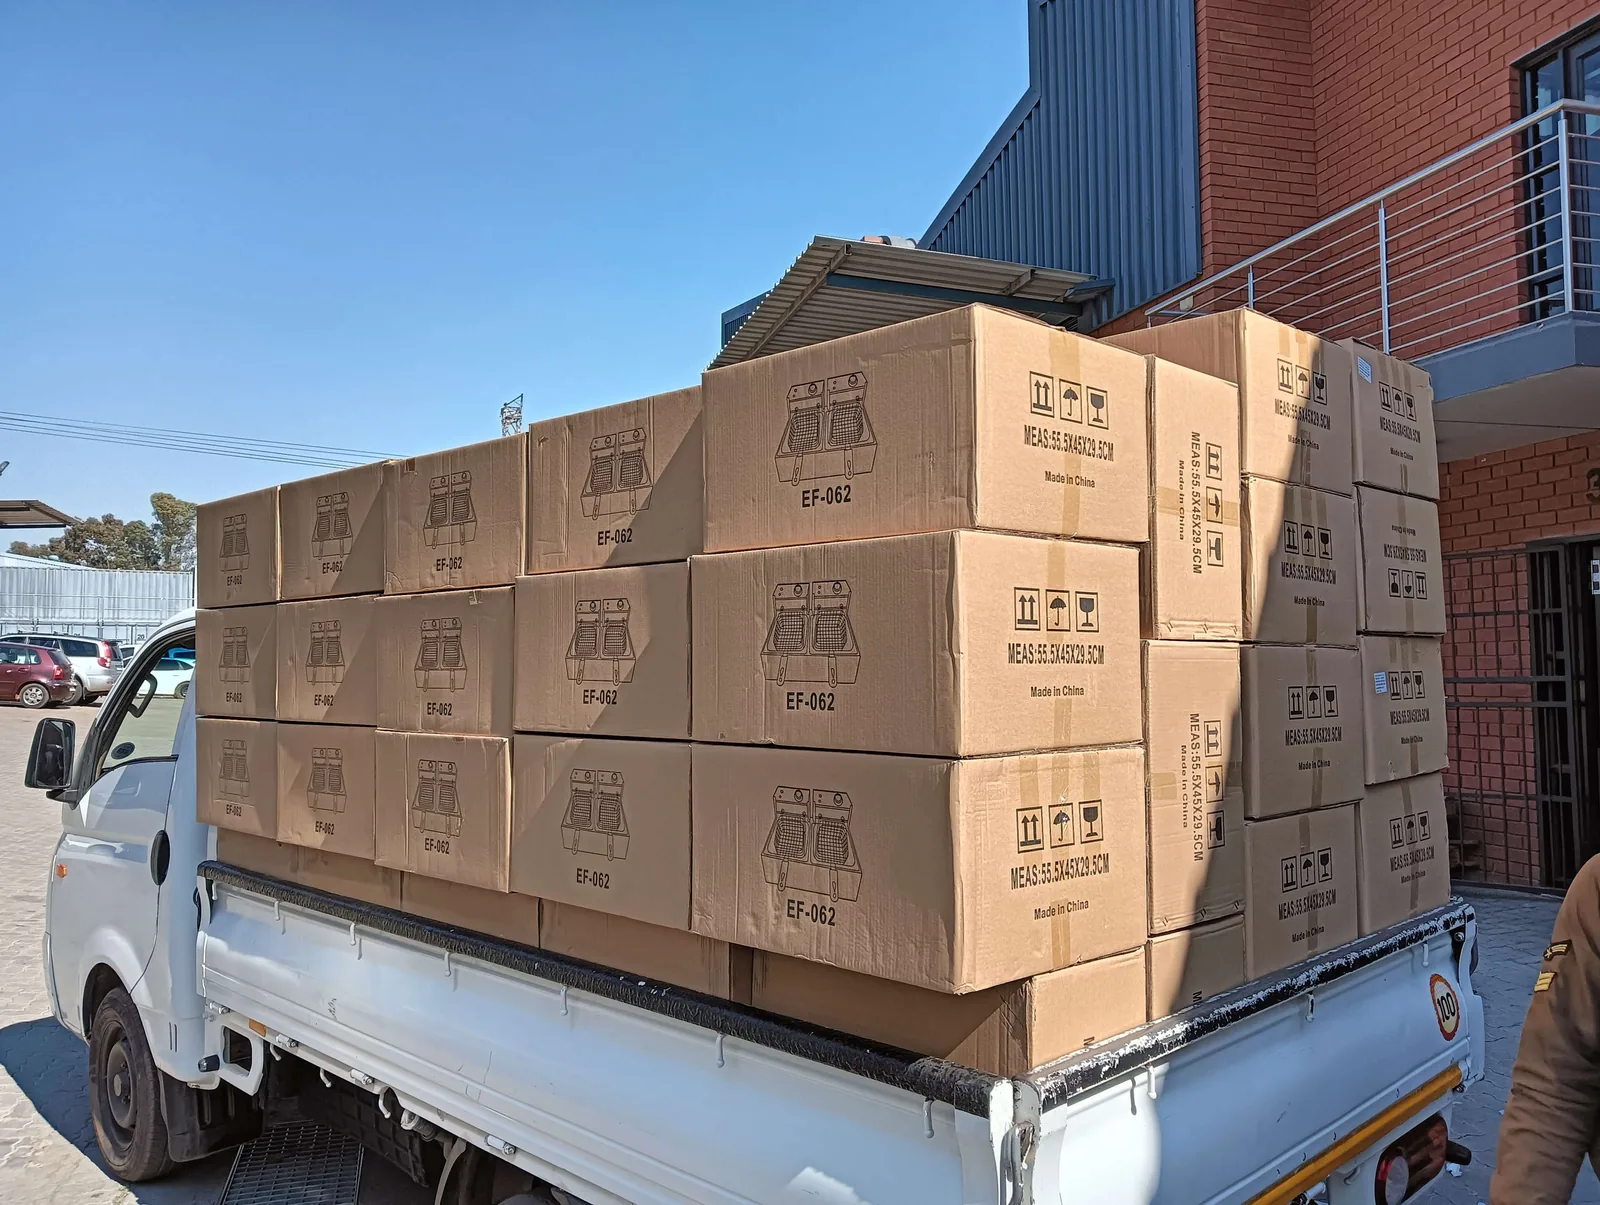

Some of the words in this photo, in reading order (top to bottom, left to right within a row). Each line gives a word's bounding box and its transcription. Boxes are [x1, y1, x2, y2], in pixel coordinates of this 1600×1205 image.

[1024, 424, 1114, 462] MEAS:55.5X45X29.5CM
[1044, 470, 1064, 484] Made
[1066, 474, 1073, 486] in
[1074, 475, 1095, 488] China
[802, 484, 852, 508] EF-062
[1191, 431, 1202, 574] MEAS:55.5X45X29.5CM
[597, 528, 632, 546] EF-062
[322, 561, 344, 574] EF-062
[435, 556, 462, 572] EF-062
[1008, 642, 1105, 665] MEAS:55.5X45X29.5CM
[314, 694, 334, 706] EF-062
[582, 688, 618, 706] EF-062
[1031, 686, 1052, 697] Made
[1053, 686, 1060, 696] in
[1062, 685, 1084, 696] China
[426, 702, 452, 716] EF-062
[786, 692, 835, 711] EF-062
[1285, 726, 1342, 746] MEAS:55.5X45X29.5CM
[1190, 713, 1204, 861] MEAS:55.5X45X29.5CM
[315, 821, 335, 836] EF-062
[424, 838, 450, 855] EF-062
[576, 868, 610, 890] EF-062
[1010, 852, 1110, 890] MEAS:55.5X45X29.5CM
[787, 898, 836, 926] EF-062
[1034, 906, 1056, 920] Made
[1058, 904, 1065, 914] in
[1067, 900, 1089, 913] China
[1278, 888, 1336, 920] MEAS:55.5X45X29.5CM
[1437, 992, 1456, 1022] 100
